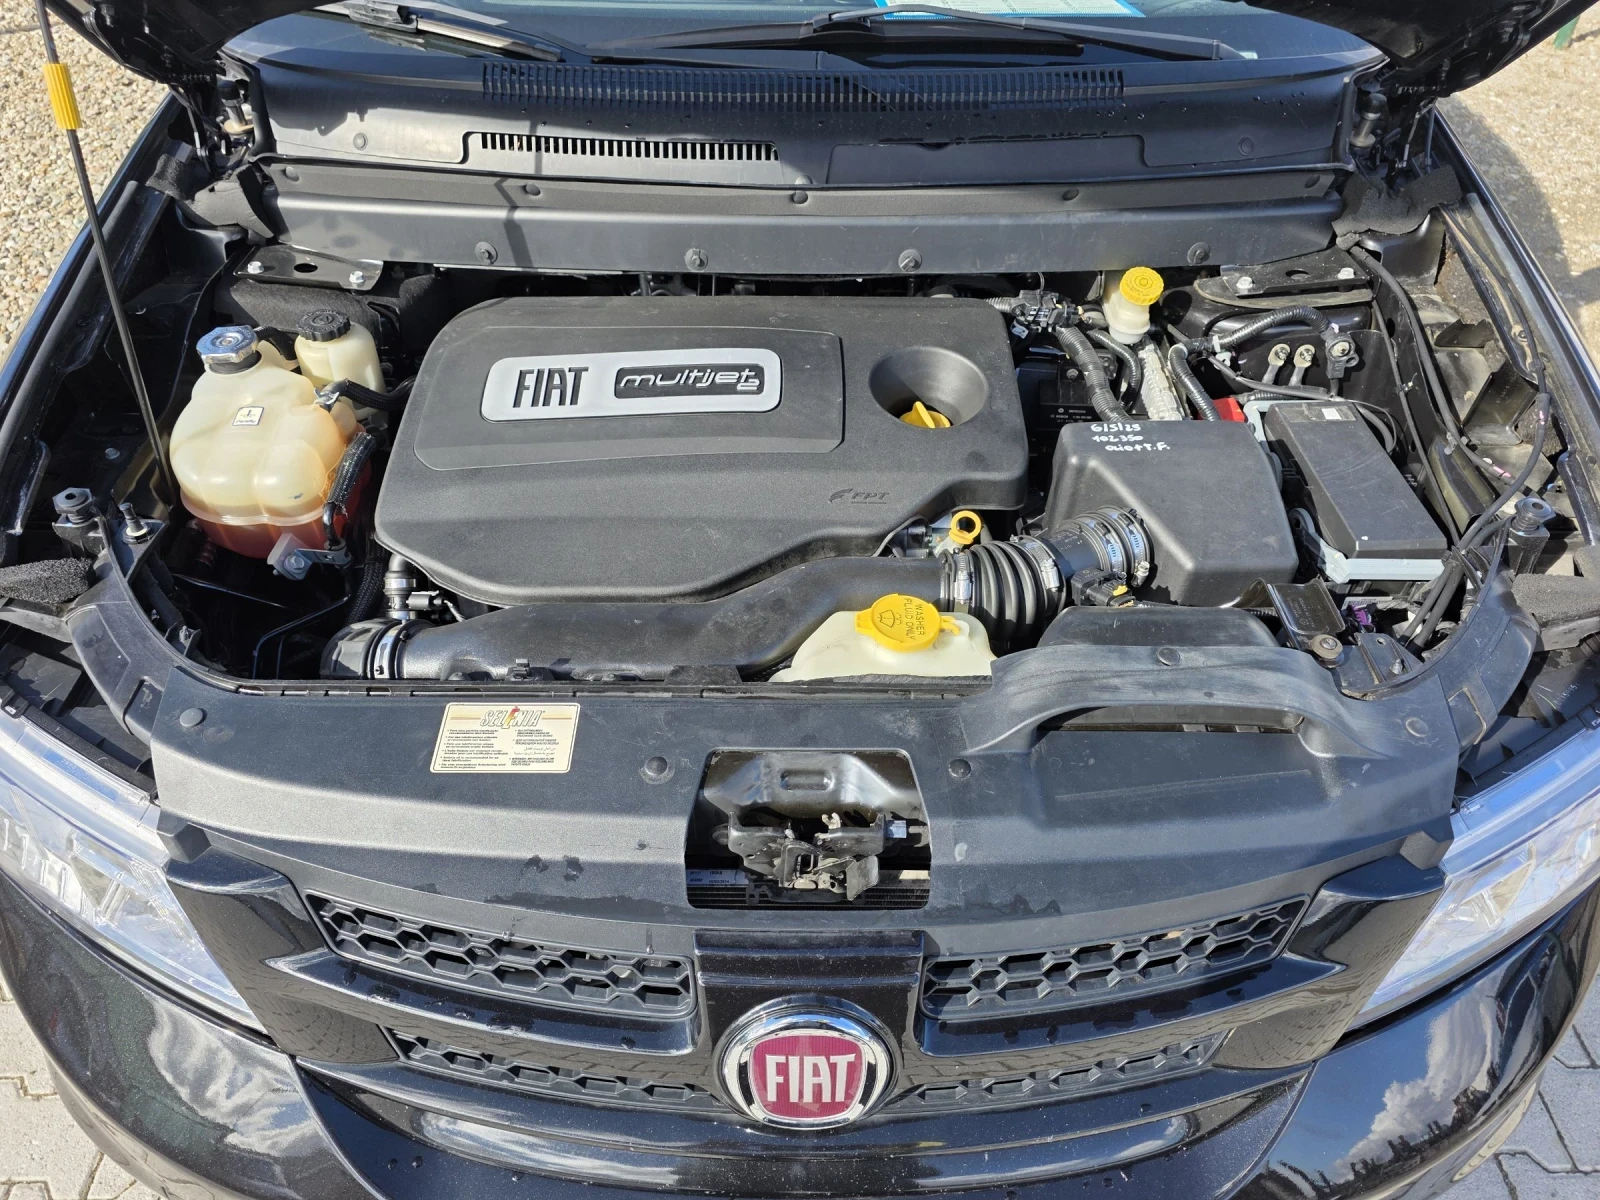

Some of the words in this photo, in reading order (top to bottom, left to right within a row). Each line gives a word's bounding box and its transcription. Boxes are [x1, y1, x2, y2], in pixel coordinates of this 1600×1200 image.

[512, 366, 589, 408] FIAT
[850, 491, 890, 501] FPT
[903, 598, 914, 620] FLUID
[915, 604, 925, 636] WASHER
[905, 621, 916, 640] ONLY
[480, 706, 543, 730] SELENIA
[765, 1053, 857, 1104] FIAT
